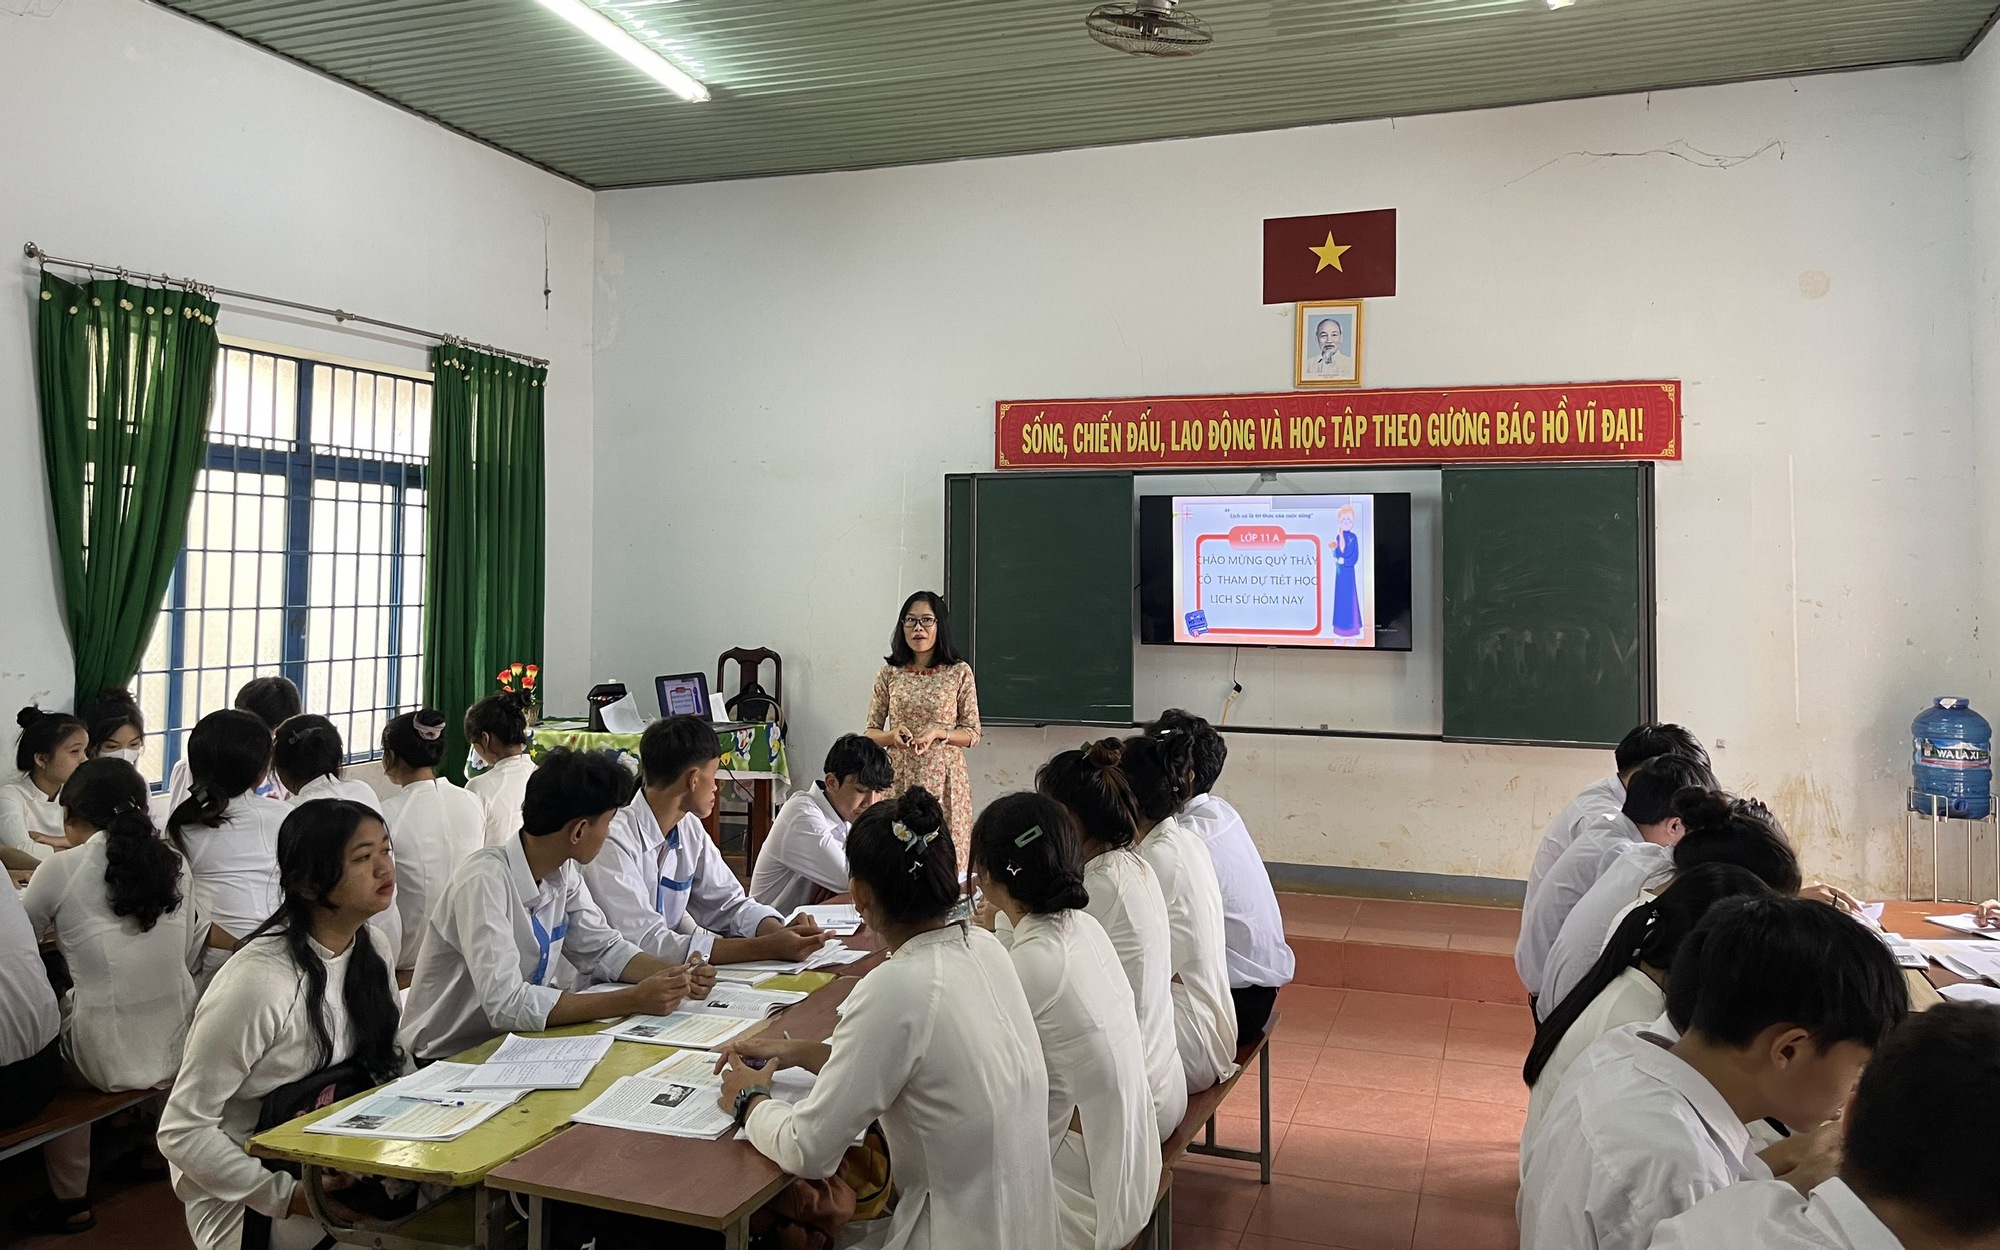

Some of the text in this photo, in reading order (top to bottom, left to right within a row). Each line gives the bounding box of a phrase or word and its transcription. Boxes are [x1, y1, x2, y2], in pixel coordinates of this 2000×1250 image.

[1021, 395, 1644, 459] SỐNG, CHIẾN ĐẤU, LAO ĐỘNG VÀ HỌC TẬP THEO GƯƠNG BÁC HỒ VĨ ĐẠI!
[1240, 532, 1280, 542] LỚP 11 A
[1197, 553, 1226, 565] CHÀO
[1228, 554, 1262, 565] MỪNG
[1264, 554, 1288, 567] QUÝ
[1197, 573, 1318, 587] CÔ THAM DỰ TIẾT HỌC
[1282, 595, 1304, 605] NAY
